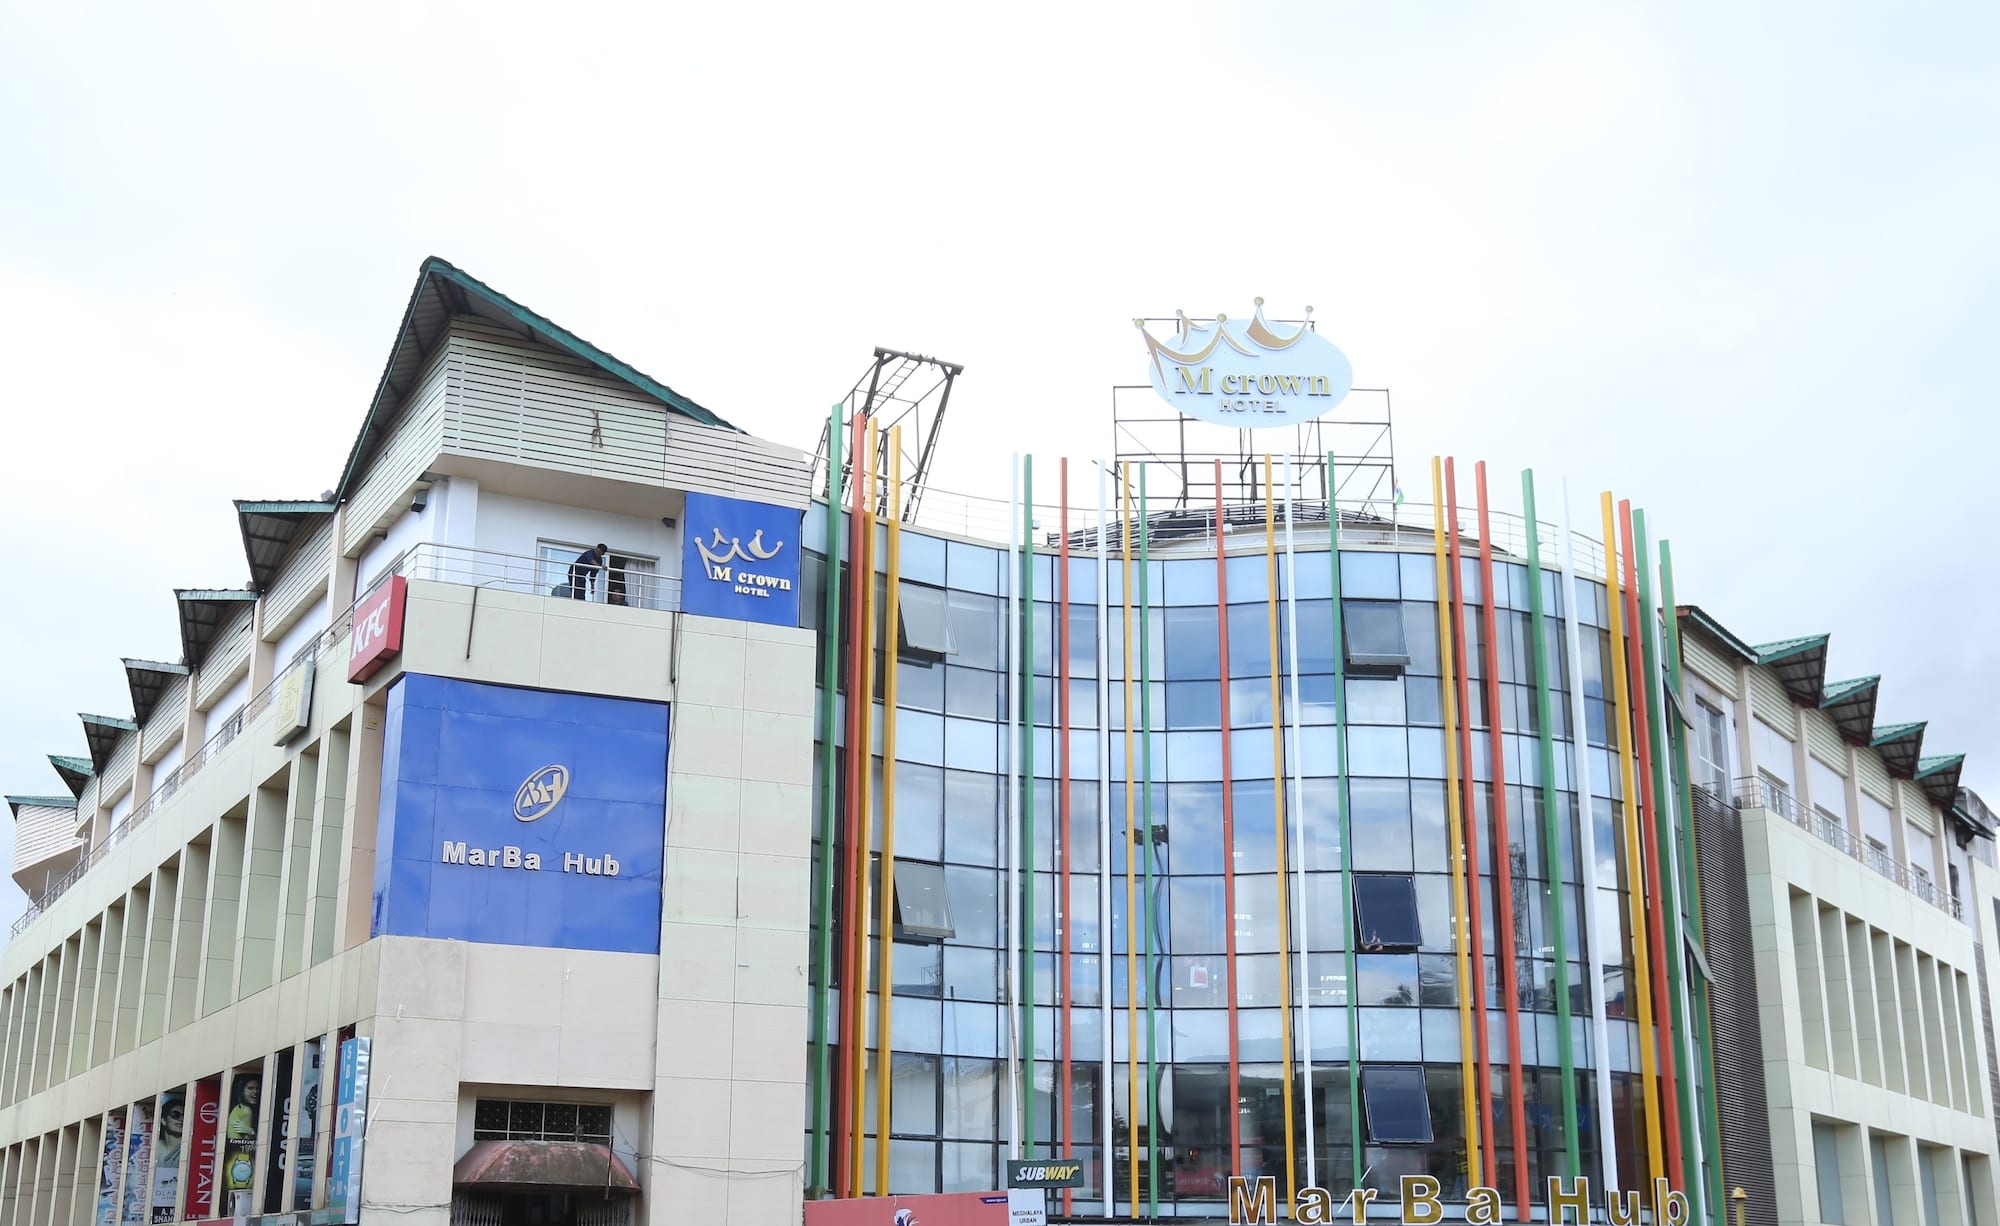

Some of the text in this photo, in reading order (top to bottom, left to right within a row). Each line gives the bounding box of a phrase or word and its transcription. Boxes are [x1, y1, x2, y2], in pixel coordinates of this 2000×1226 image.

[1175, 366, 1332, 396] M crown
[1219, 399, 1287, 413] HOTEL
[712, 565, 791, 591] M crown
[734, 585, 770, 597] HOTEL
[351, 596, 391, 661] KFC
[442, 841, 620, 877] MarBa Hub
[196, 1135, 217, 1204] TITAN
[1015, 1165, 1080, 1181] SUBWAY
[1227, 1175, 1690, 1226] MarBa Hub
